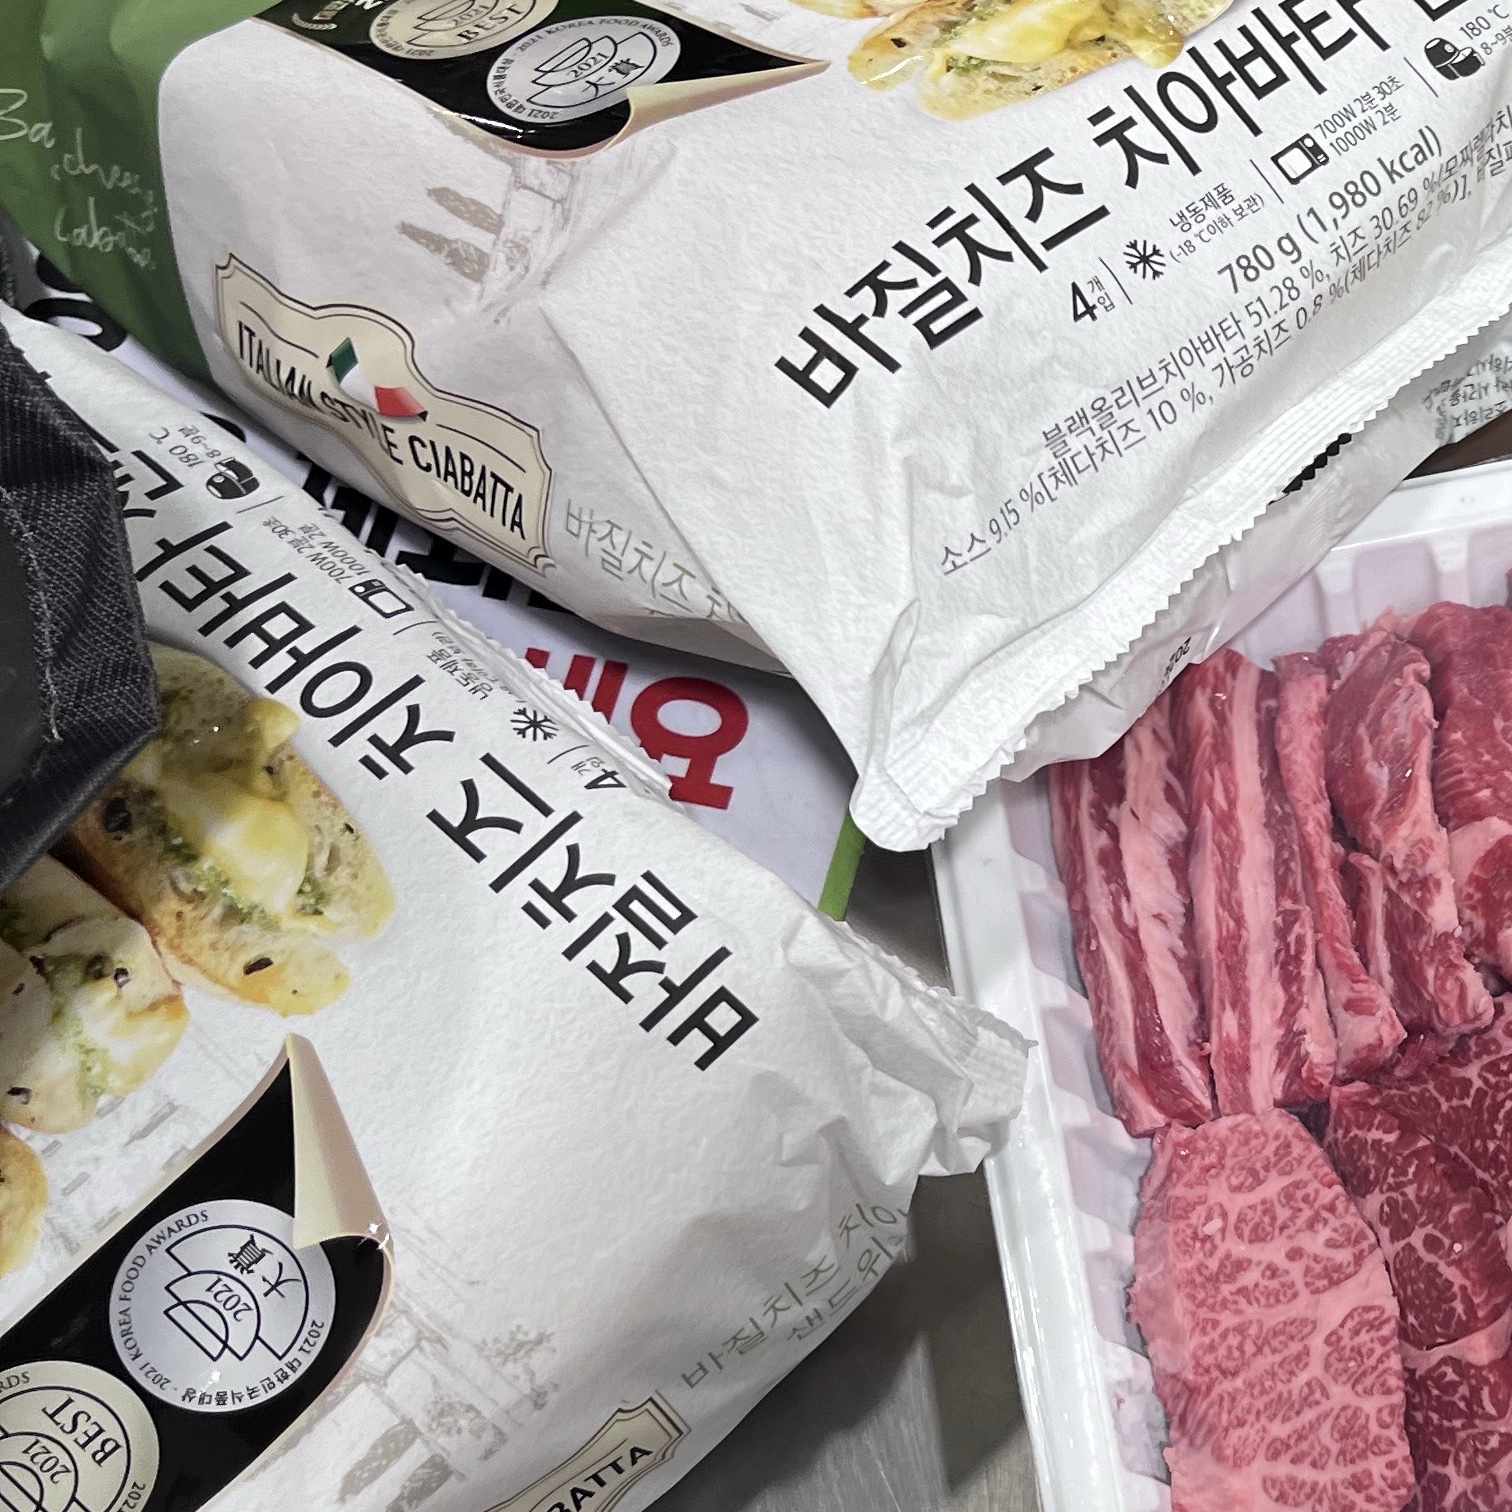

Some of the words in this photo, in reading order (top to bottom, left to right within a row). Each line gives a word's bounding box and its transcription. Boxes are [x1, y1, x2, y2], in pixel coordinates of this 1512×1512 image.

[456, 3, 525, 44] BEST
[545, 18, 596, 36] KOREA
[598, 16, 640, 29] FOOD
[1460, 16, 1491, 40] 180
[568, 51, 609, 79] 2021
[1314, 104, 1357, 139] 700W
[1353, 92, 1378, 113] 2분
[1372, 76, 1404, 100] 30초
[1330, 116, 1377, 156] 1000W
[1375, 103, 1401, 125] 2분
[774, 147, 1110, 408] 바질치즈
[1087, 0, 1391, 189] 치아바타
[1169, 183, 1235, 232] 냉동제품
[1218, 245, 1274, 294] 780
[1277, 233, 1302, 264] g
[1297, 170, 1381, 244] (1,980
[1377, 126, 1441, 184] kcal)
[1232, 193, 1264, 221] 보관)
[1043, 313, 1246, 459] 블랙올리브치아바타
[1245, 277, 1300, 328] 51.28
[1330, 226, 1368, 266] 치즈
[237, 319, 321, 418] ITALIAN
[408, 433, 527, 541] CIABATTA
[941, 533, 991, 575] 소스
[1147, 400, 1177, 431] 10
[1212, 319, 1291, 388] 가공치즈
[169, 445, 205, 467] 180
[307, 553, 353, 584] 700W
[320, 542, 370, 575] 1000W
[563, 500, 699, 611] 바질치즈
[136, 485, 455, 780] 치아바타
[426, 753, 759, 1071] 바질치즈
[146, 1209, 209, 1257] AWARDS
[122, 1254, 148, 1302] FOOD
[204, 1276, 254, 1323] 2021
[117, 1303, 143, 1363] KOREA
[297, 1319, 325, 1356] 2021
[681, 1256, 838, 1389] 바질치즈
[138, 1360, 171, 1392] 2021
[41, 1397, 123, 1468] BEST
[22, 1439, 74, 1486] 2021
